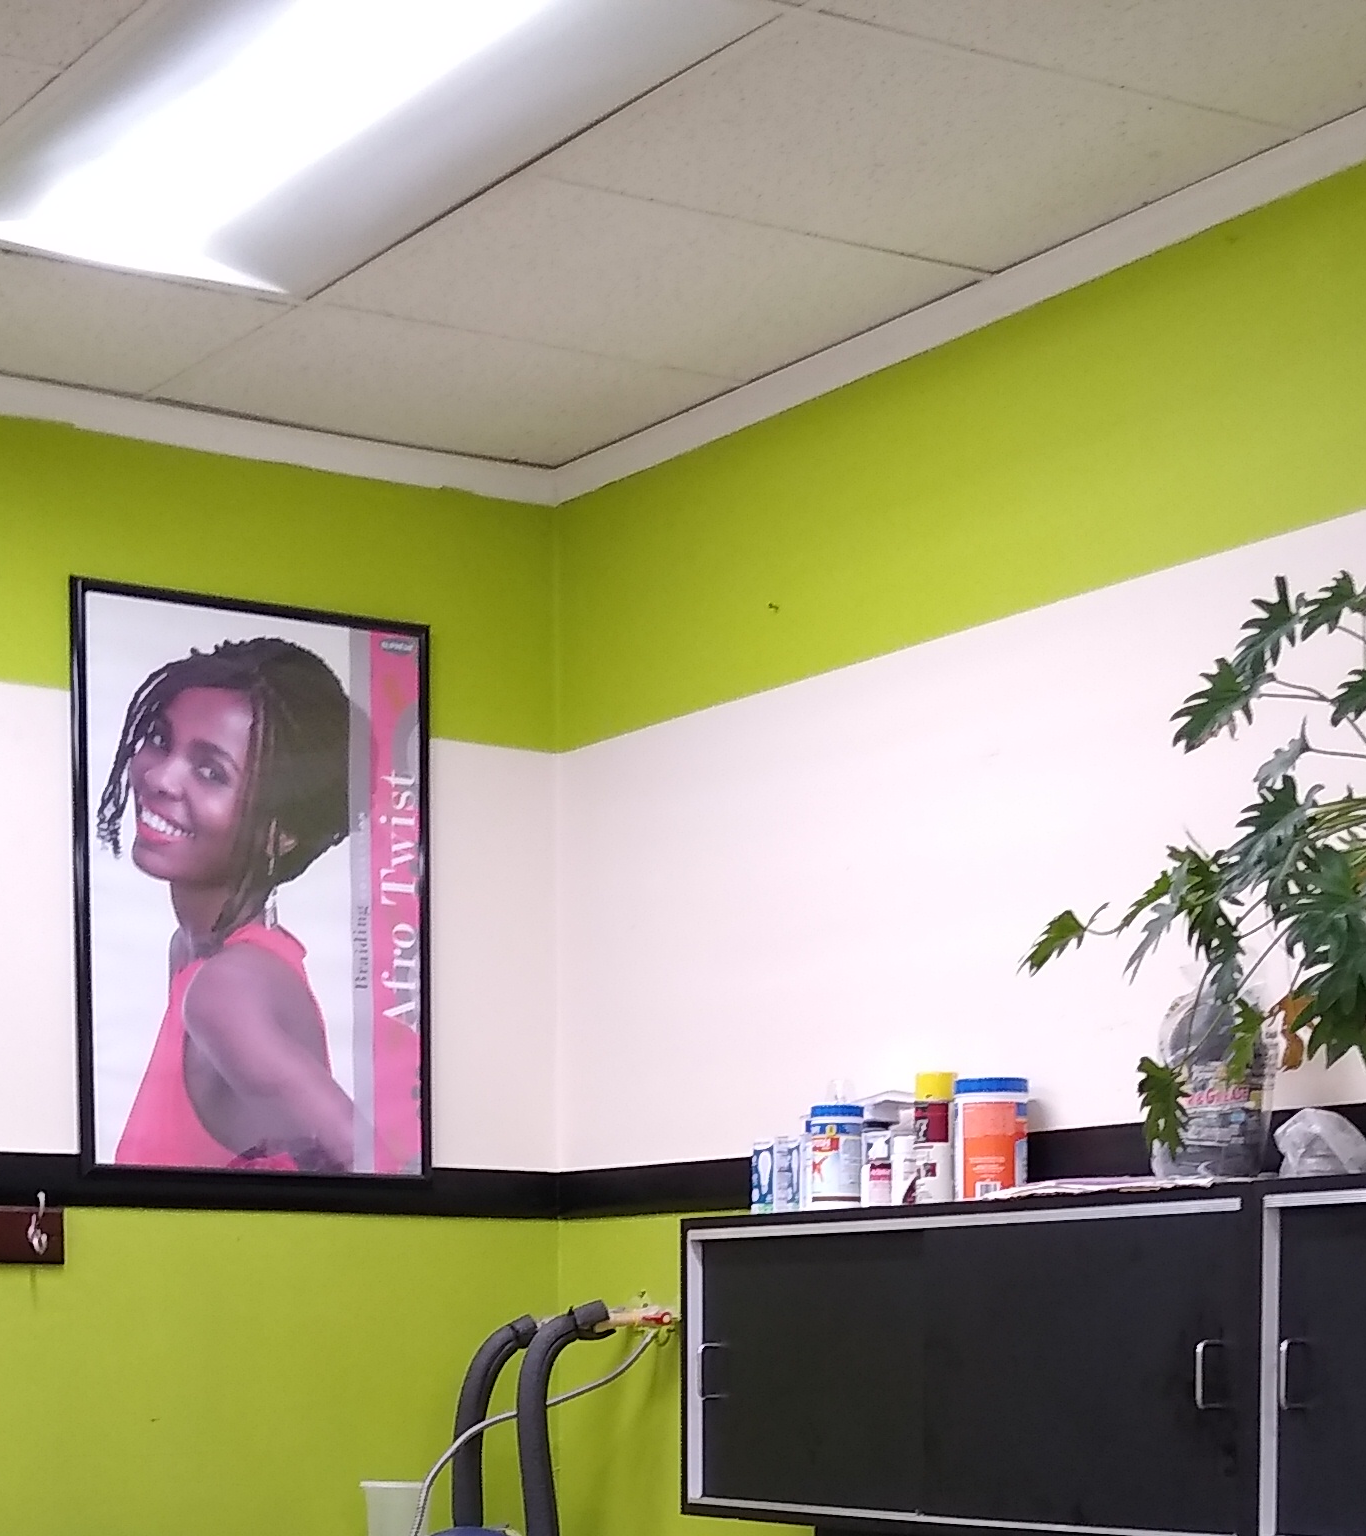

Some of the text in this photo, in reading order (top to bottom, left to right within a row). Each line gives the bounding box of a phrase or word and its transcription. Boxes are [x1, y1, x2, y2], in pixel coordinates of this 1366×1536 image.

[353, 906, 370, 989] Braiding
[379, 769, 417, 1032] Afro Twist
